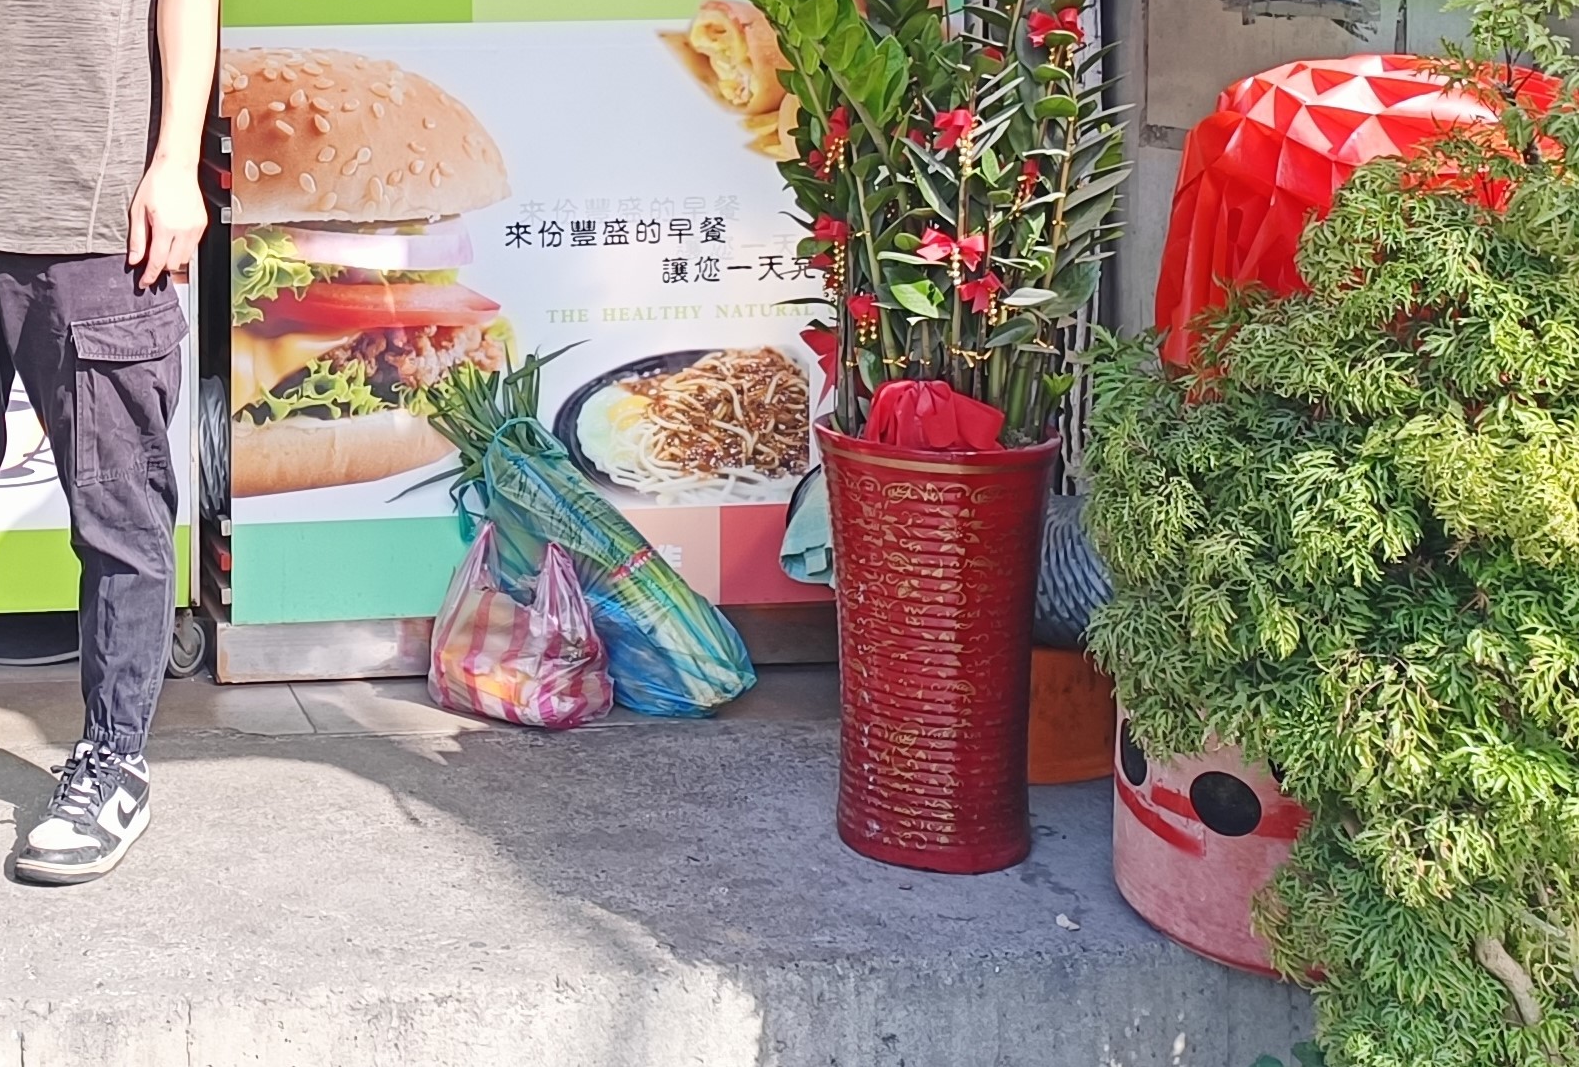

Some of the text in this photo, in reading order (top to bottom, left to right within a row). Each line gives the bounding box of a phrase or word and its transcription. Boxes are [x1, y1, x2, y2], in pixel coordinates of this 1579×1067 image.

[504, 216, 727, 249] 來份豐盛的早餐
[546, 309, 589, 323] THE
[602, 306, 703, 322] HEALTHY
[716, 302, 815, 318] NATURAL
